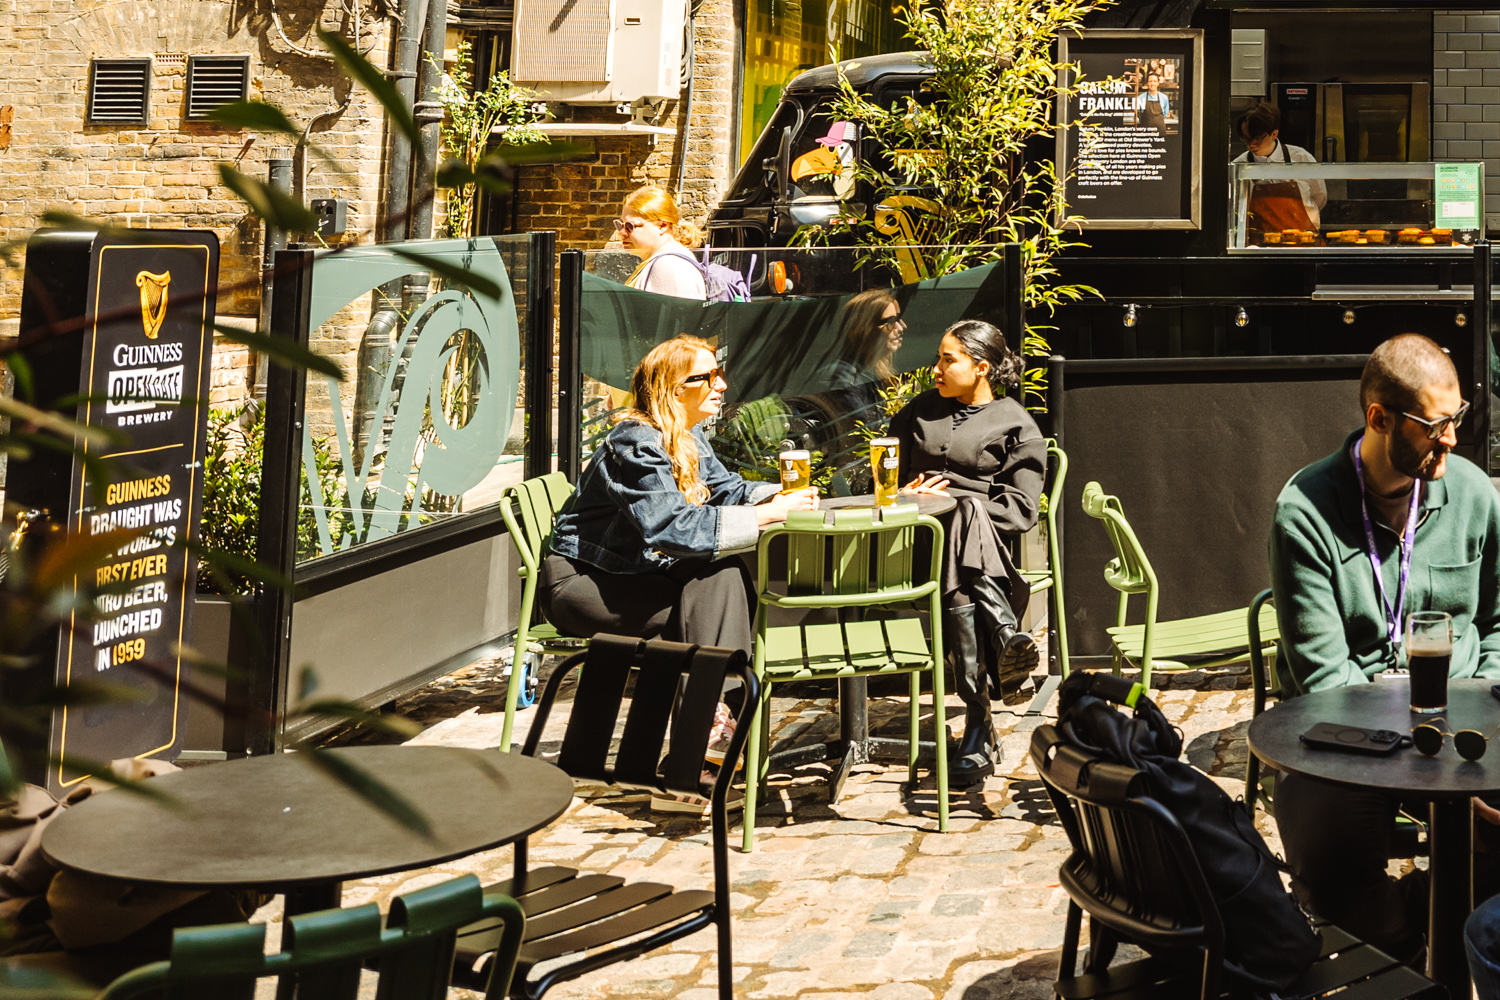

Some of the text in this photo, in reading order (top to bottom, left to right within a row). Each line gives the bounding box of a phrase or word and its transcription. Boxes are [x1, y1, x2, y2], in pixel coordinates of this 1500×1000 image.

[1079, 98, 1146, 110] FRANKLIN
[113, 342, 183, 367] GUINNESS
[117, 410, 173, 427] BREWERY
[106, 474, 171, 506] GUINNESS
[90, 498, 182, 536] DRAUGHT WAS
[96, 553, 167, 589] FIRST EVER
[124, 580, 168, 608] BEER,
[93, 608, 162, 647] LAUNCHED
[96, 638, 146, 672] IN 1959
